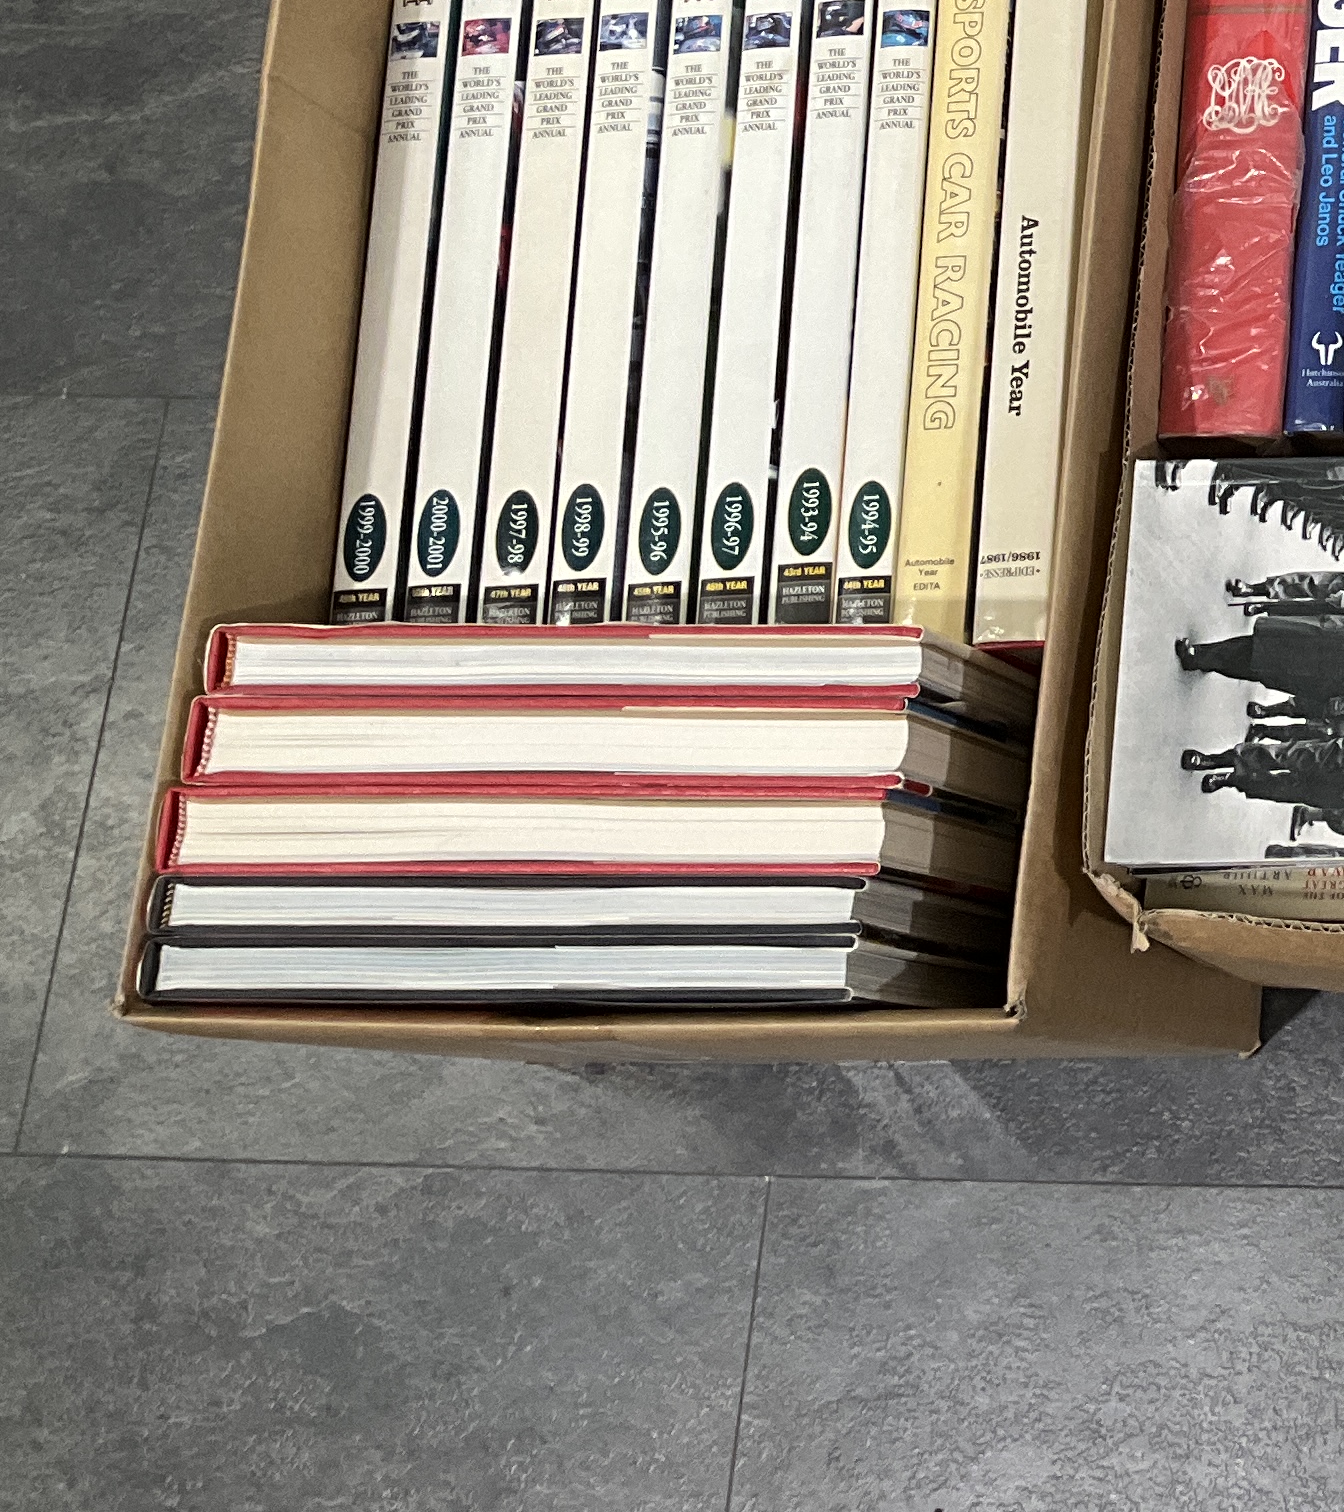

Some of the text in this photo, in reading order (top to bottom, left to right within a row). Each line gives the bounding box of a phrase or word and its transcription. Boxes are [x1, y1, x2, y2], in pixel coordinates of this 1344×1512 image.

[936, 152, 974, 243] CAR
[924, 255, 967, 431] RACING
[1008, 215, 1039, 417] Automobile Year
[354, 498, 376, 576] 1999-2000
[575, 496, 593, 559] 1998-99
[800, 480, 820, 547] 1993-94
[862, 490, 883, 551] 1994-95
[914, 582, 941, 591] EDITA
